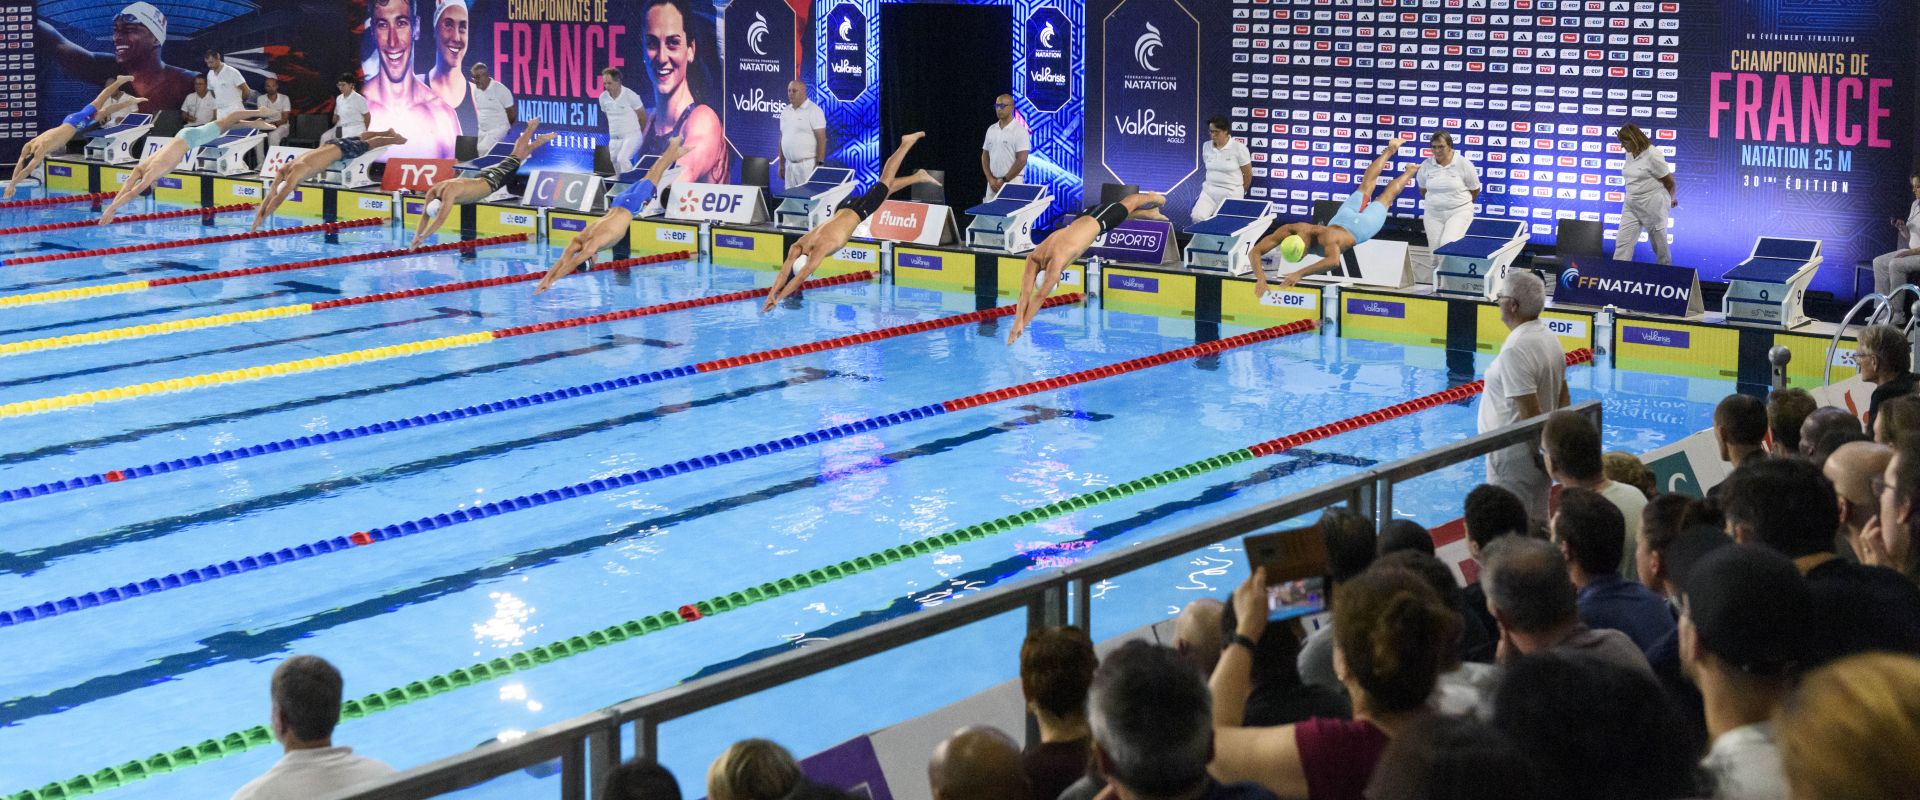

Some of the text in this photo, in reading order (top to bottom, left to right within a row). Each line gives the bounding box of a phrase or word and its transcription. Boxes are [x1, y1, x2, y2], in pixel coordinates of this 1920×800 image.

[508, 0, 608, 23] CHAMPIONNATS DE
[739, 62, 780, 73] NATATION
[1731, 50, 1870, 76] CHAMPIONNATS DE
[1124, 81, 1177, 91] NATATION
[518, 100, 598, 127] NATATION 25 M
[1708, 71, 1893, 148] FRANCE
[1742, 144, 1852, 172] NATATION 25 M
[400, 164, 438, 186] TYR
[537, 177, 583, 204] CIC
[1785, 175, 1849, 193] ÉDITION
[803, 203, 809, 215] 5
[1021, 222, 1028, 235] 6
[1109, 232, 1157, 248] SPORTS
[1217, 241, 1224, 251] 7
[1468, 262, 1477, 276] 8
[1500, 264, 1506, 279] 8
[1577, 276, 1690, 301] FFNATATION
[1759, 289, 1769, 301] 9
